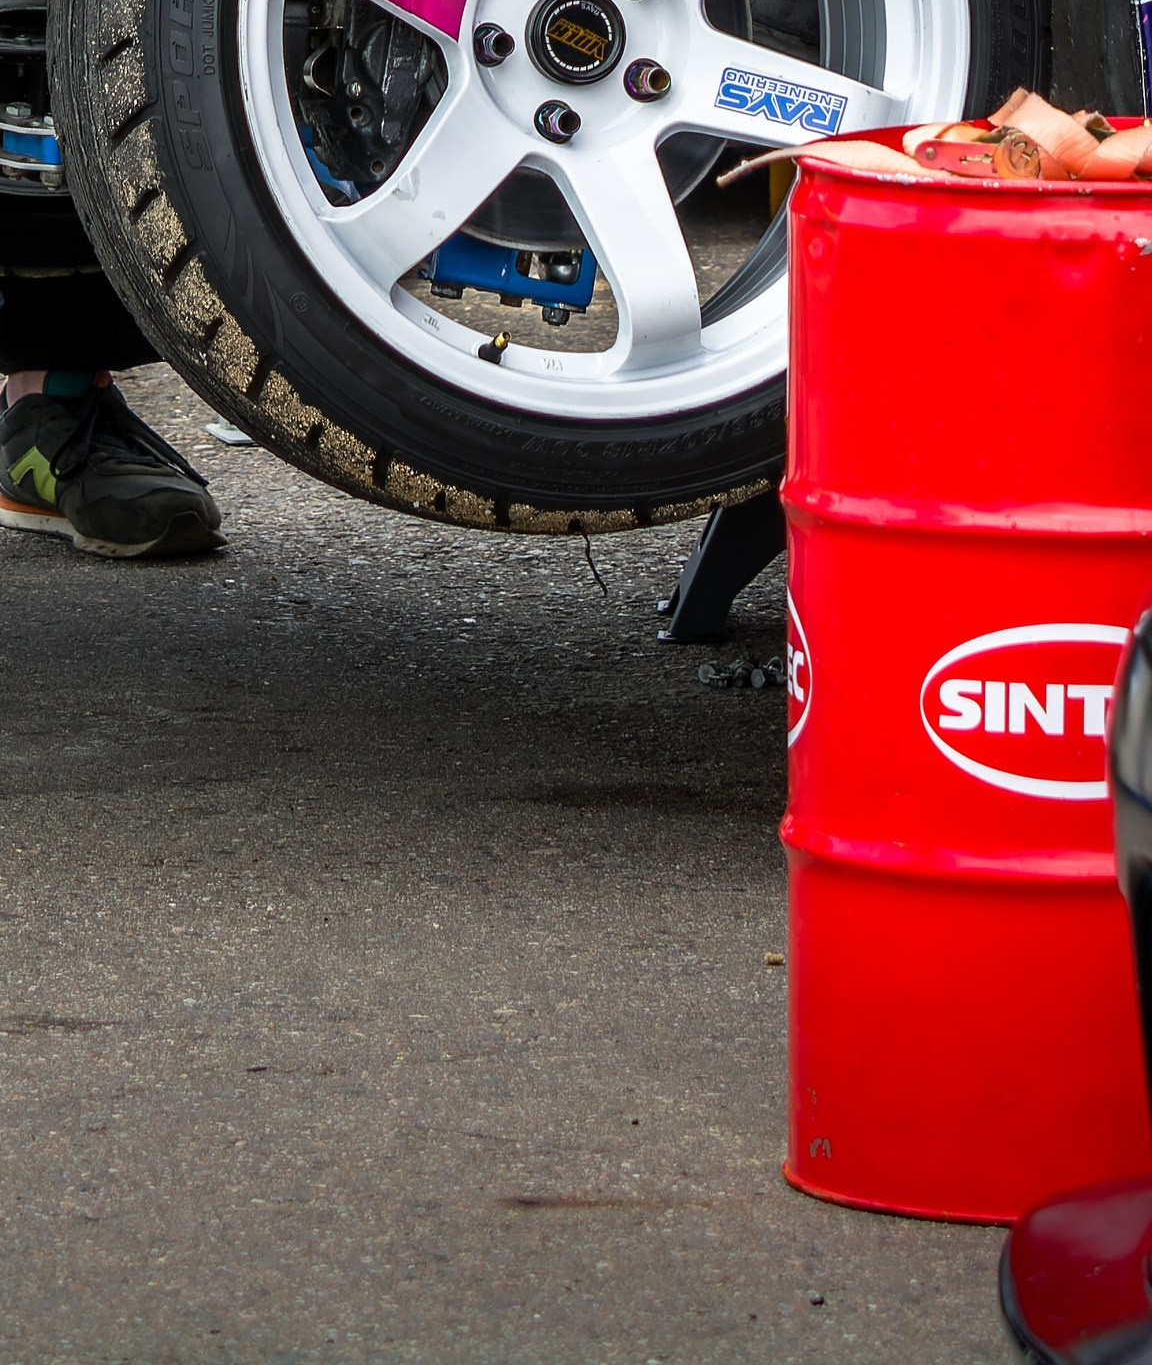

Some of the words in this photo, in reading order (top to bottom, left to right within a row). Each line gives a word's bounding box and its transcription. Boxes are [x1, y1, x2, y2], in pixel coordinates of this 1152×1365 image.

[201, 43, 215, 76] DOT
[717, 81, 841, 134] RAYS
[726, 70, 844, 110] ENGINEERING
